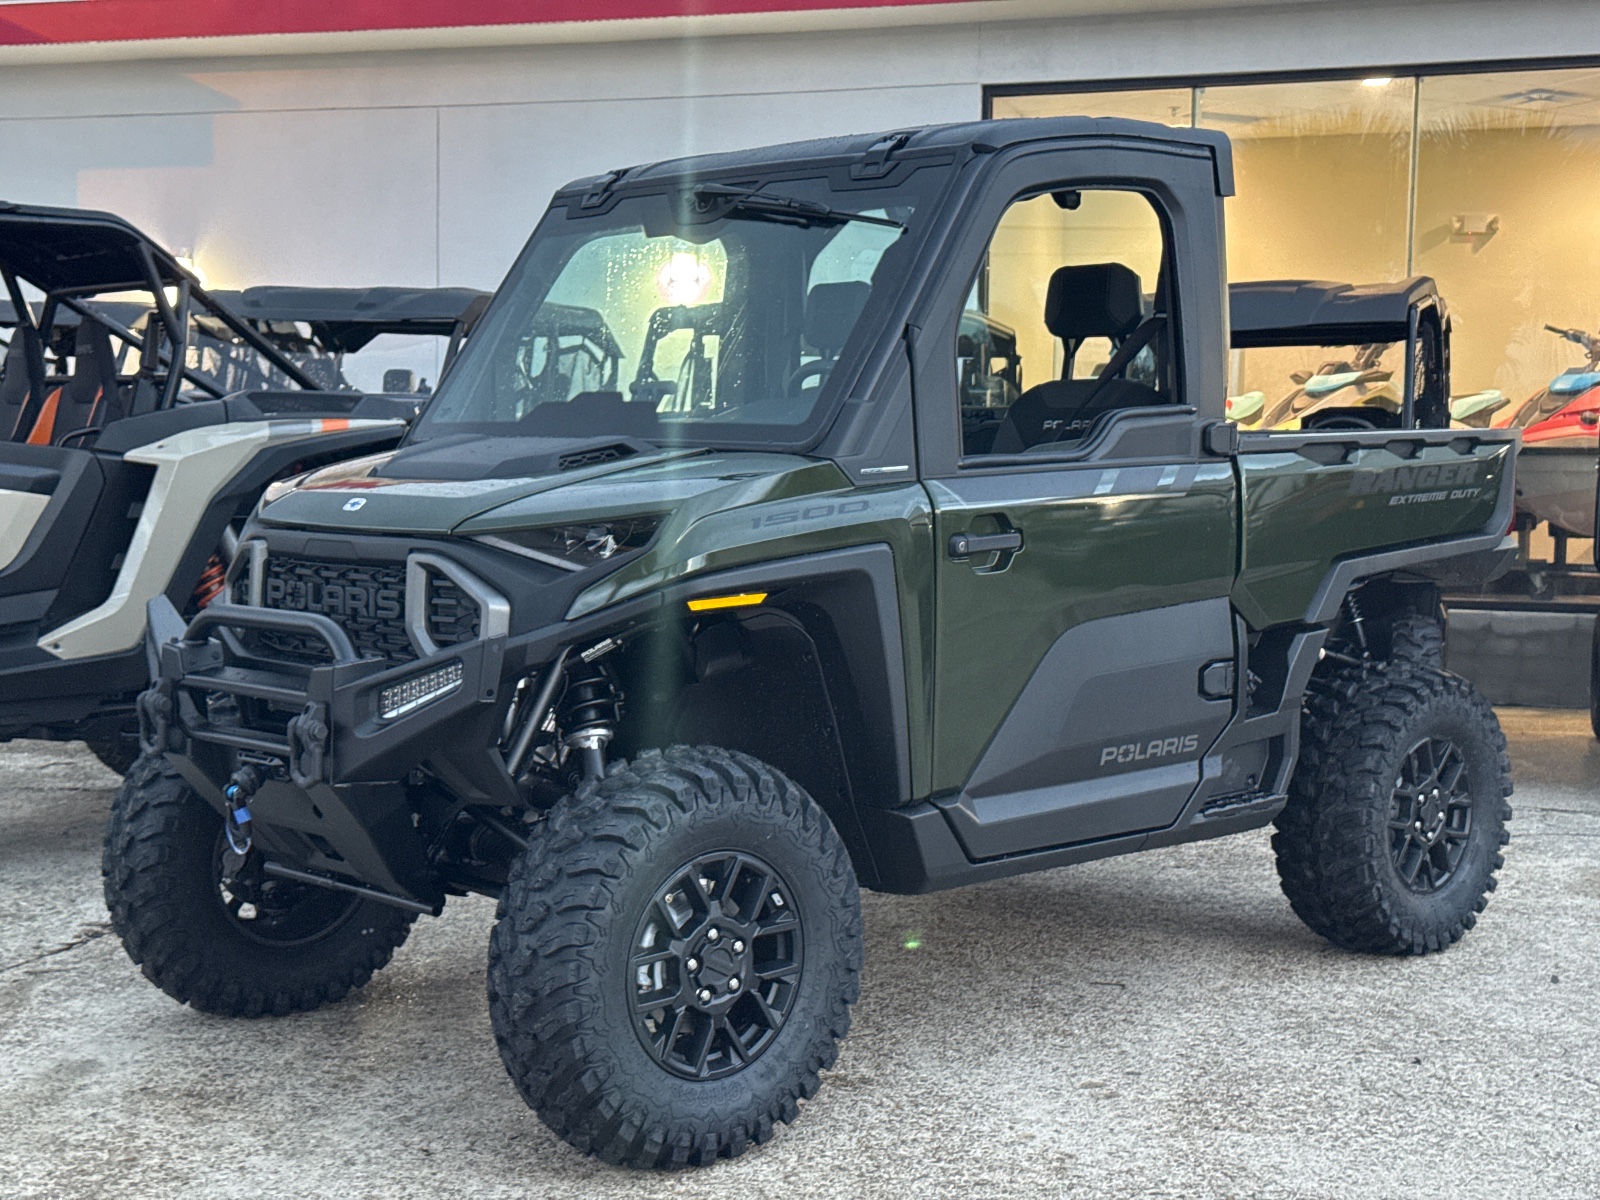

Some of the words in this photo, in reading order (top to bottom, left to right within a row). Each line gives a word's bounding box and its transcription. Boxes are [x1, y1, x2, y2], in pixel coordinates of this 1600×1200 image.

[1350, 462, 1479, 496] RANGER
[1388, 490, 1449, 506] EXTREME
[1450, 487, 1482, 499] DUTY
[750, 500, 870, 530] 1500
[266, 577, 401, 619] POLARIS
[1100, 734, 1199, 766] POLARIS
